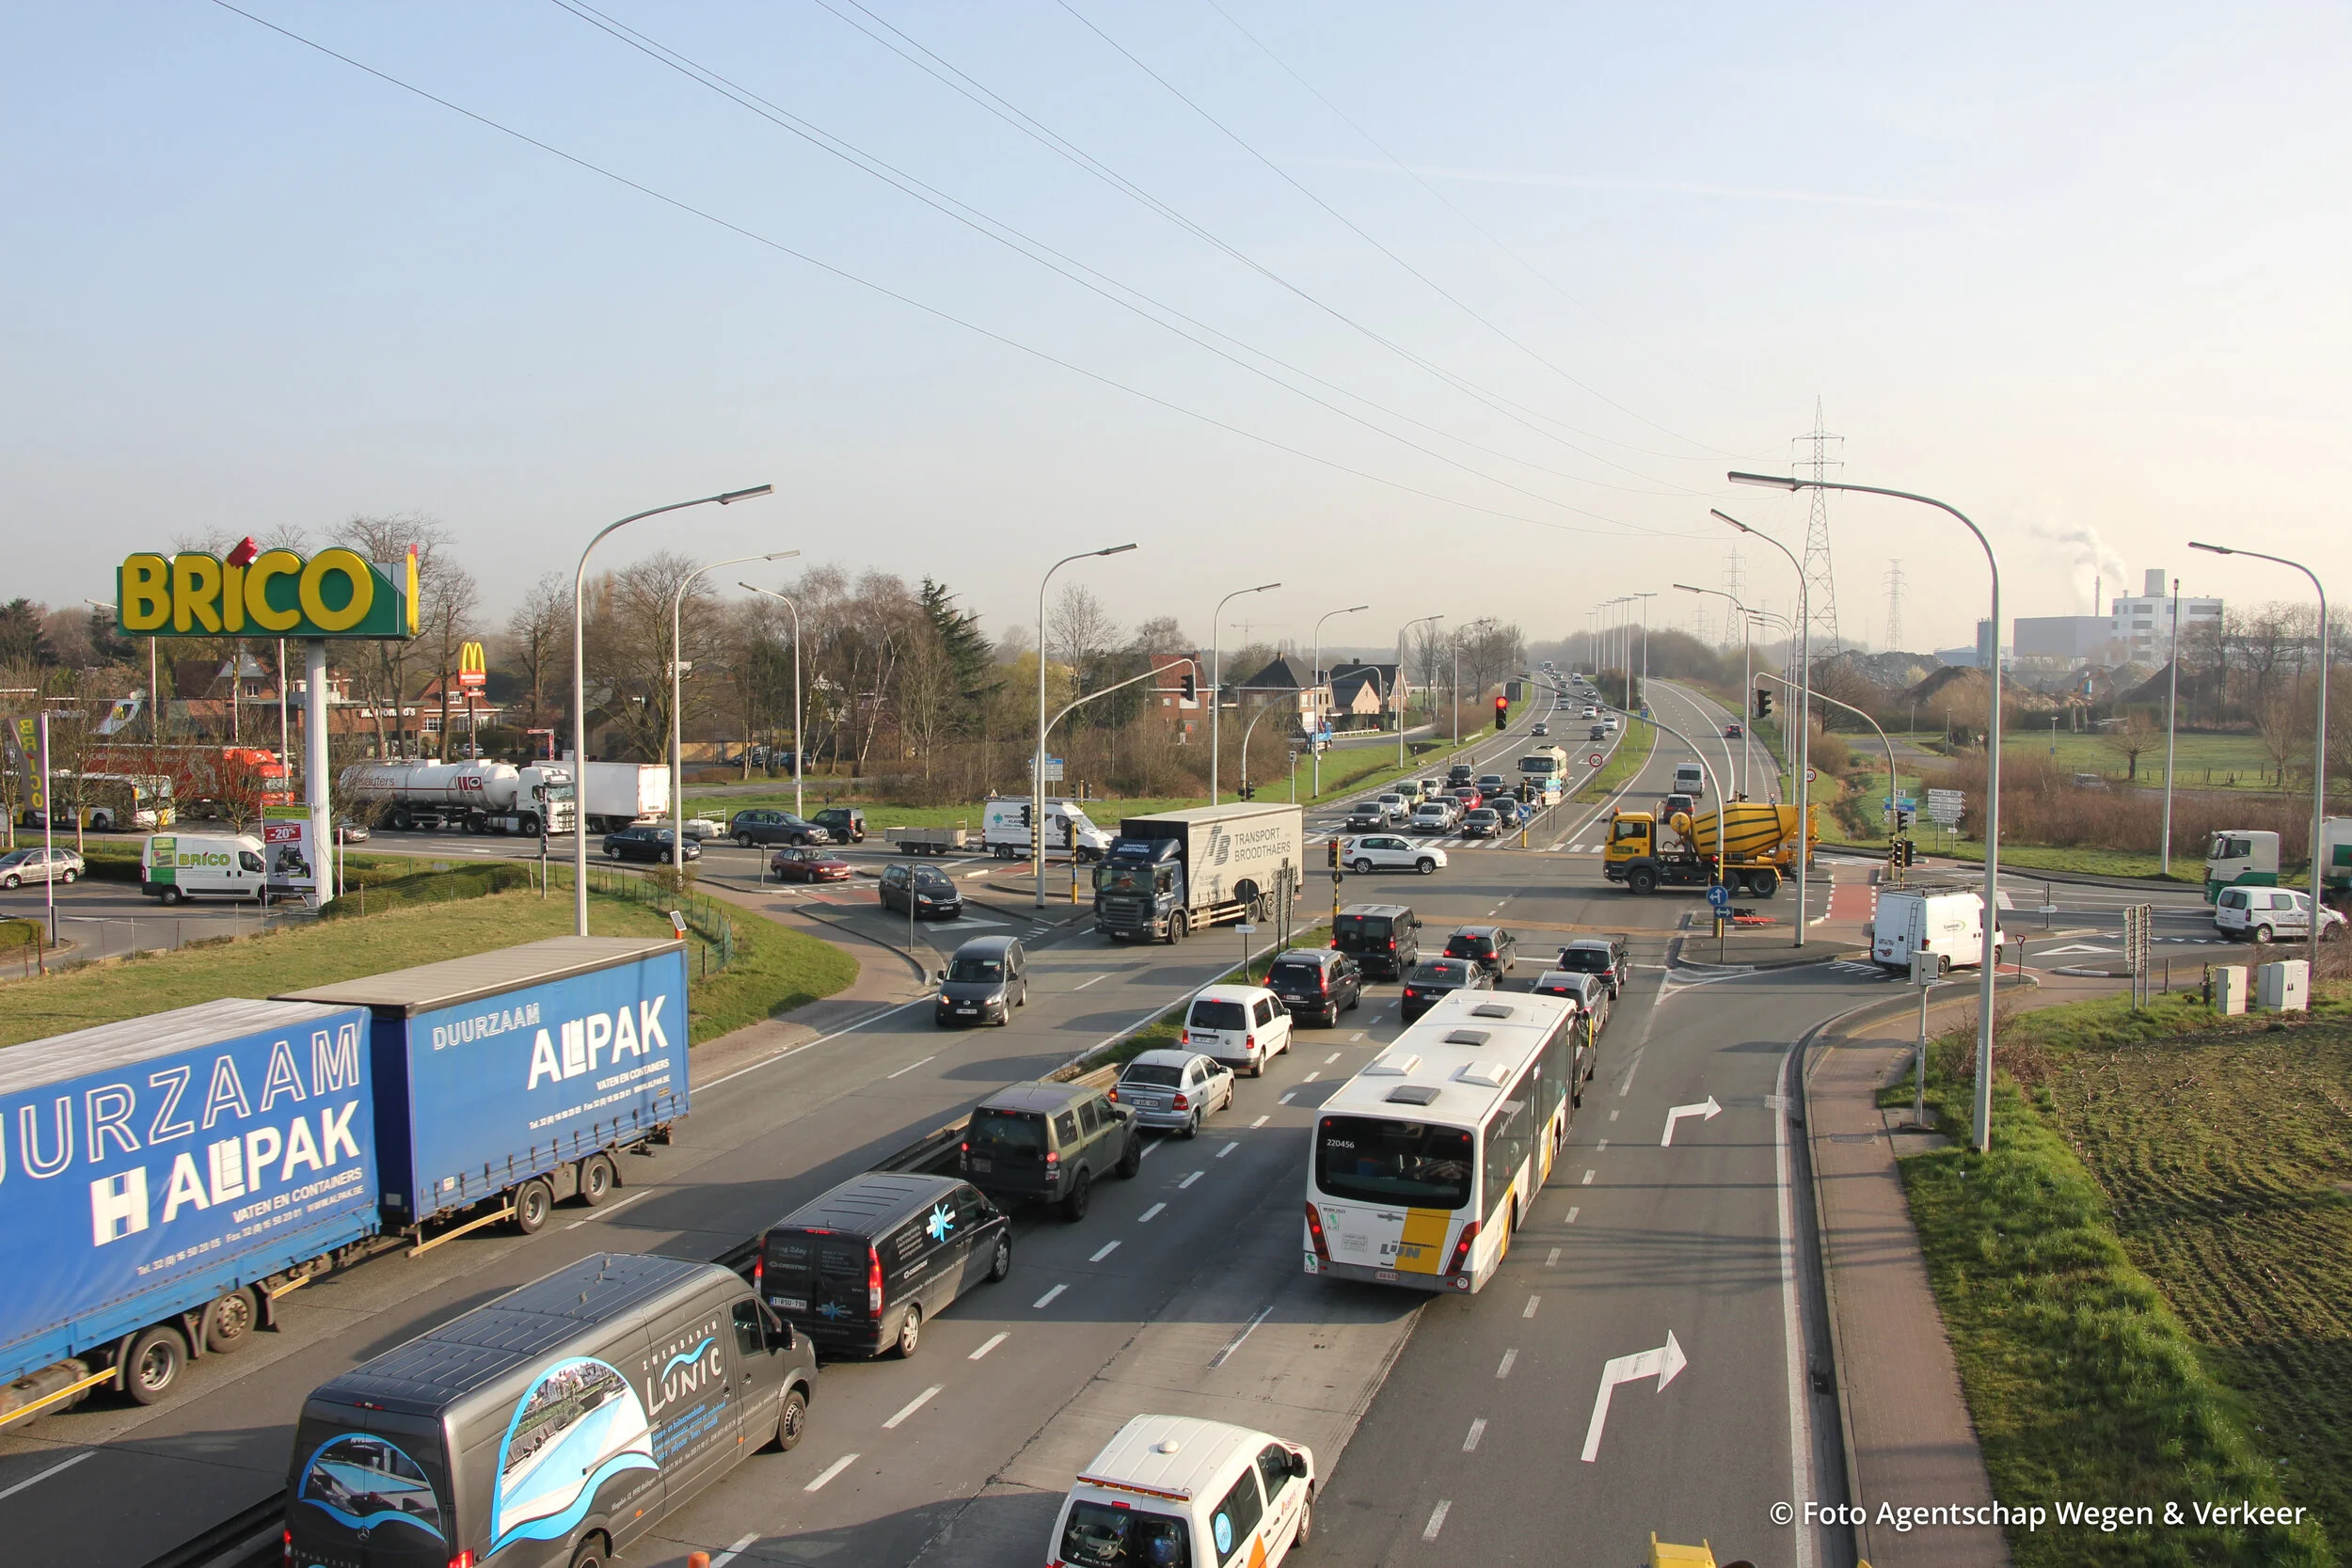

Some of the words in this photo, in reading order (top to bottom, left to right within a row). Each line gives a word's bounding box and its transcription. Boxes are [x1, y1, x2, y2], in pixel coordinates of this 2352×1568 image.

[122, 543, 373, 633] BRICO
[179, 853, 230, 866] BRICO
[1234, 827, 1280, 846] TRANSPORT
[1234, 841, 1292, 863] BROODTHAERS
[433, 1003, 541, 1051] DUURZAAM
[527, 994, 669, 1091] ALPAK
[596, 1076, 619, 1091] VATEN
[619, 1073, 630, 1084] EN
[630, 1058, 670, 1080] CONTAINERS
[0, 1022, 360, 1186] URZAAM
[1327, 1138, 1355, 1149] 220456
[232, 1200, 272, 1224] VATEN
[274, 1193, 290, 1210] EN
[292, 1166, 363, 1203] CONTAINERS
[307, 1184, 364, 1213] WWW.ALPAK.BE
[643, 1320, 717, 1370] ZWEMBADEN
[646, 1347, 723, 1417] LUNIC
